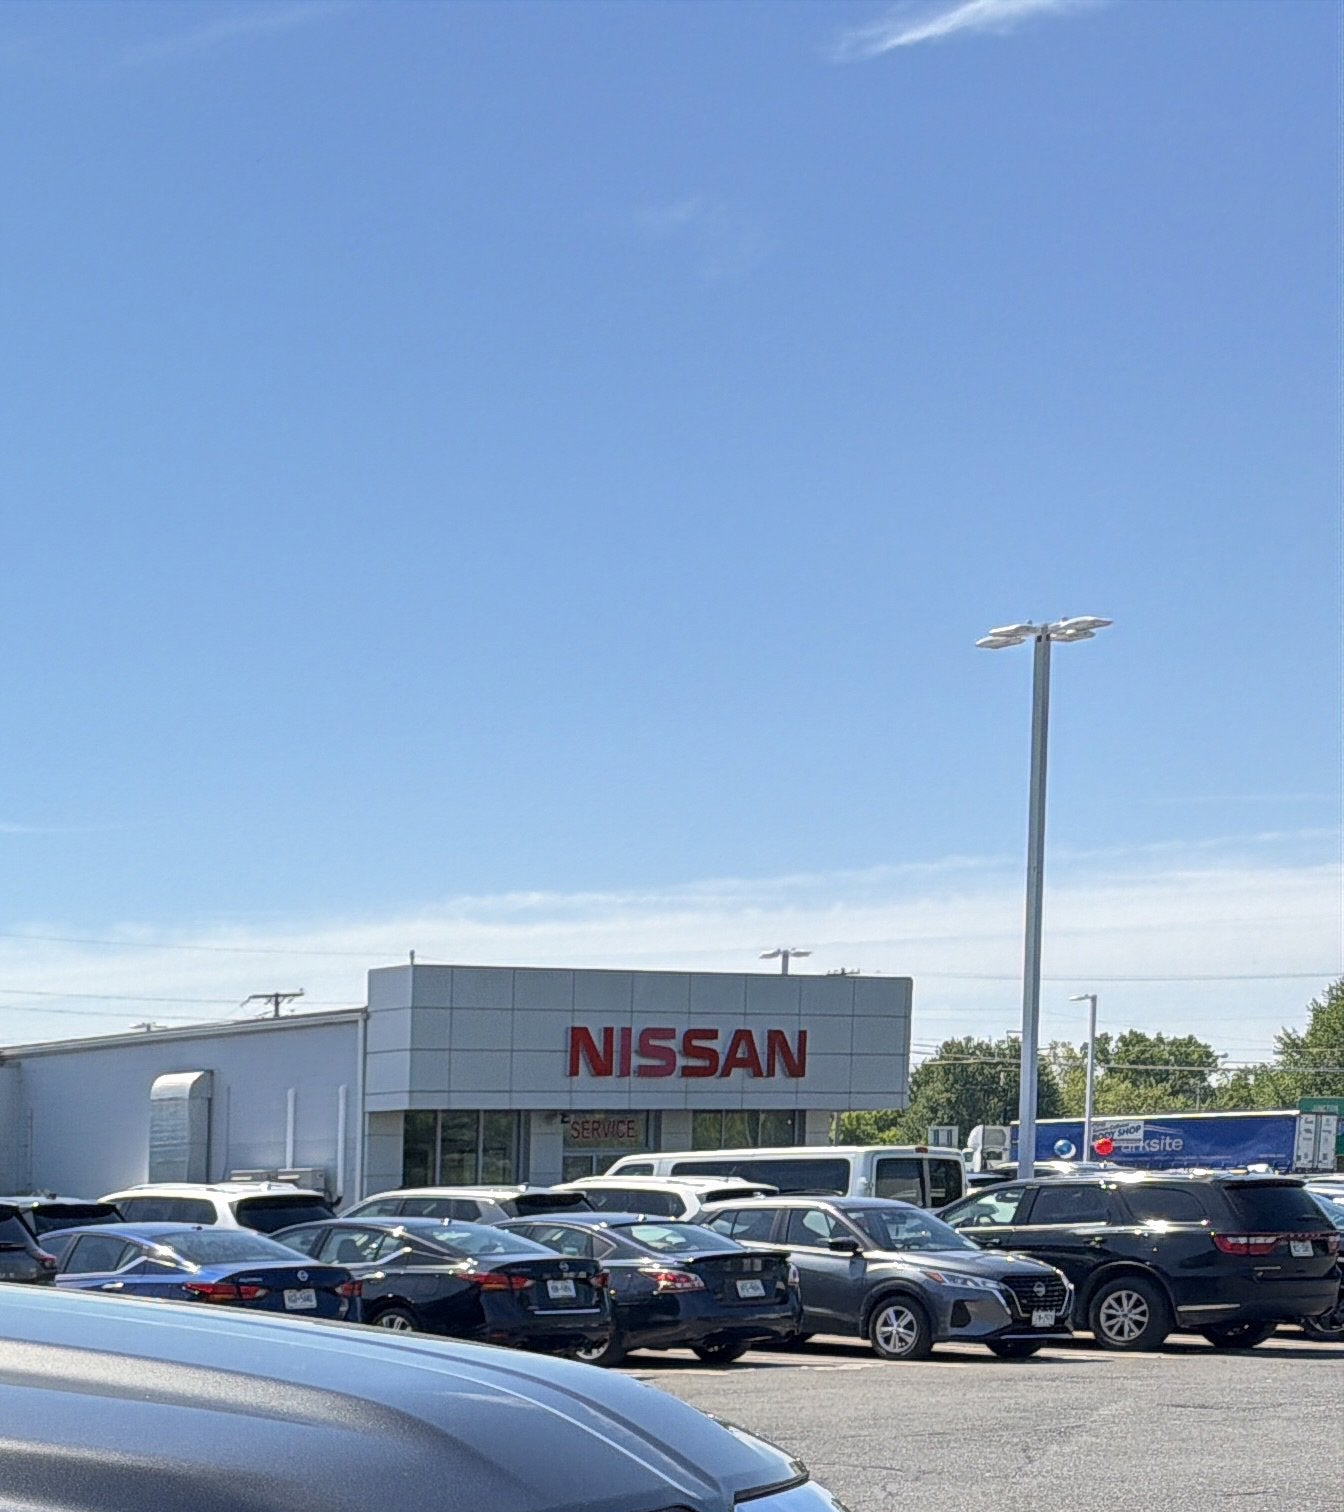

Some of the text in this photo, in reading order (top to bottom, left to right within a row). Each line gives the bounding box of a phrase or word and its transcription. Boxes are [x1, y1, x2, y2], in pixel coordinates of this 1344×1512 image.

[568, 1026, 807, 1078] NISSAN
[571, 1120, 637, 1140] SERVICE
[1116, 1125, 1141, 1137] SHOP
[1120, 1136, 1184, 1153] arksite
